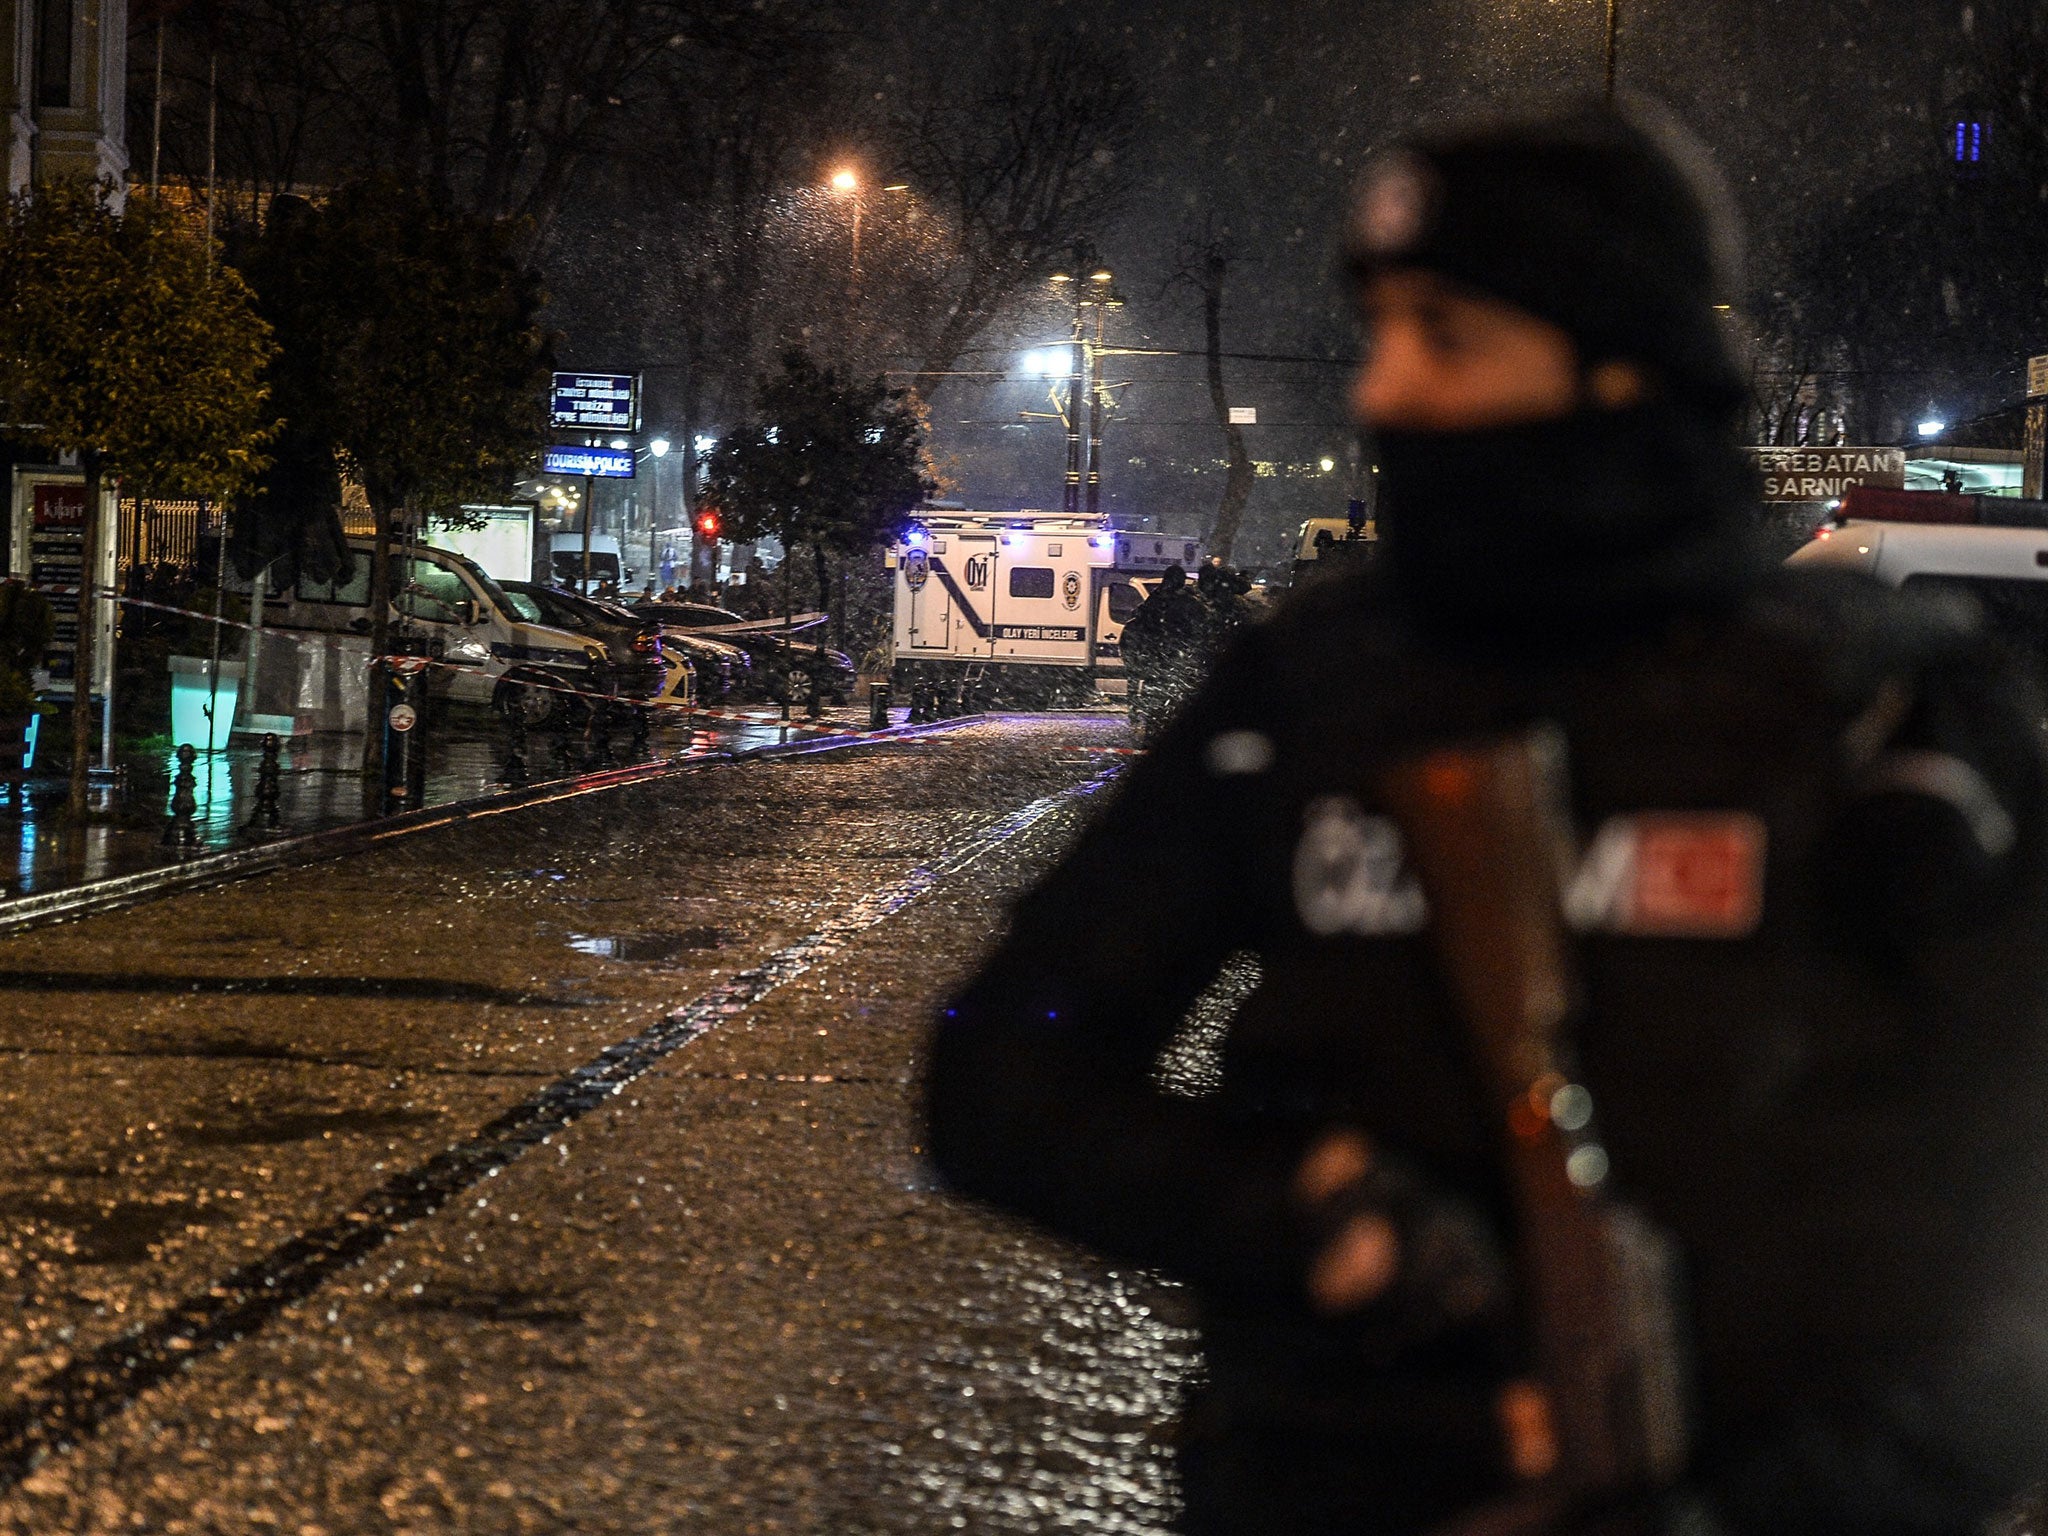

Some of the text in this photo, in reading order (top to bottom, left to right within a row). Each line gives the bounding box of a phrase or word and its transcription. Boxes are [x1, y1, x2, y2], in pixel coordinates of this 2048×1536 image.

[594, 457, 632, 471] POLICE
[1002, 627, 1022, 638] OLAY
[1023, 626, 1041, 639] YERİ
